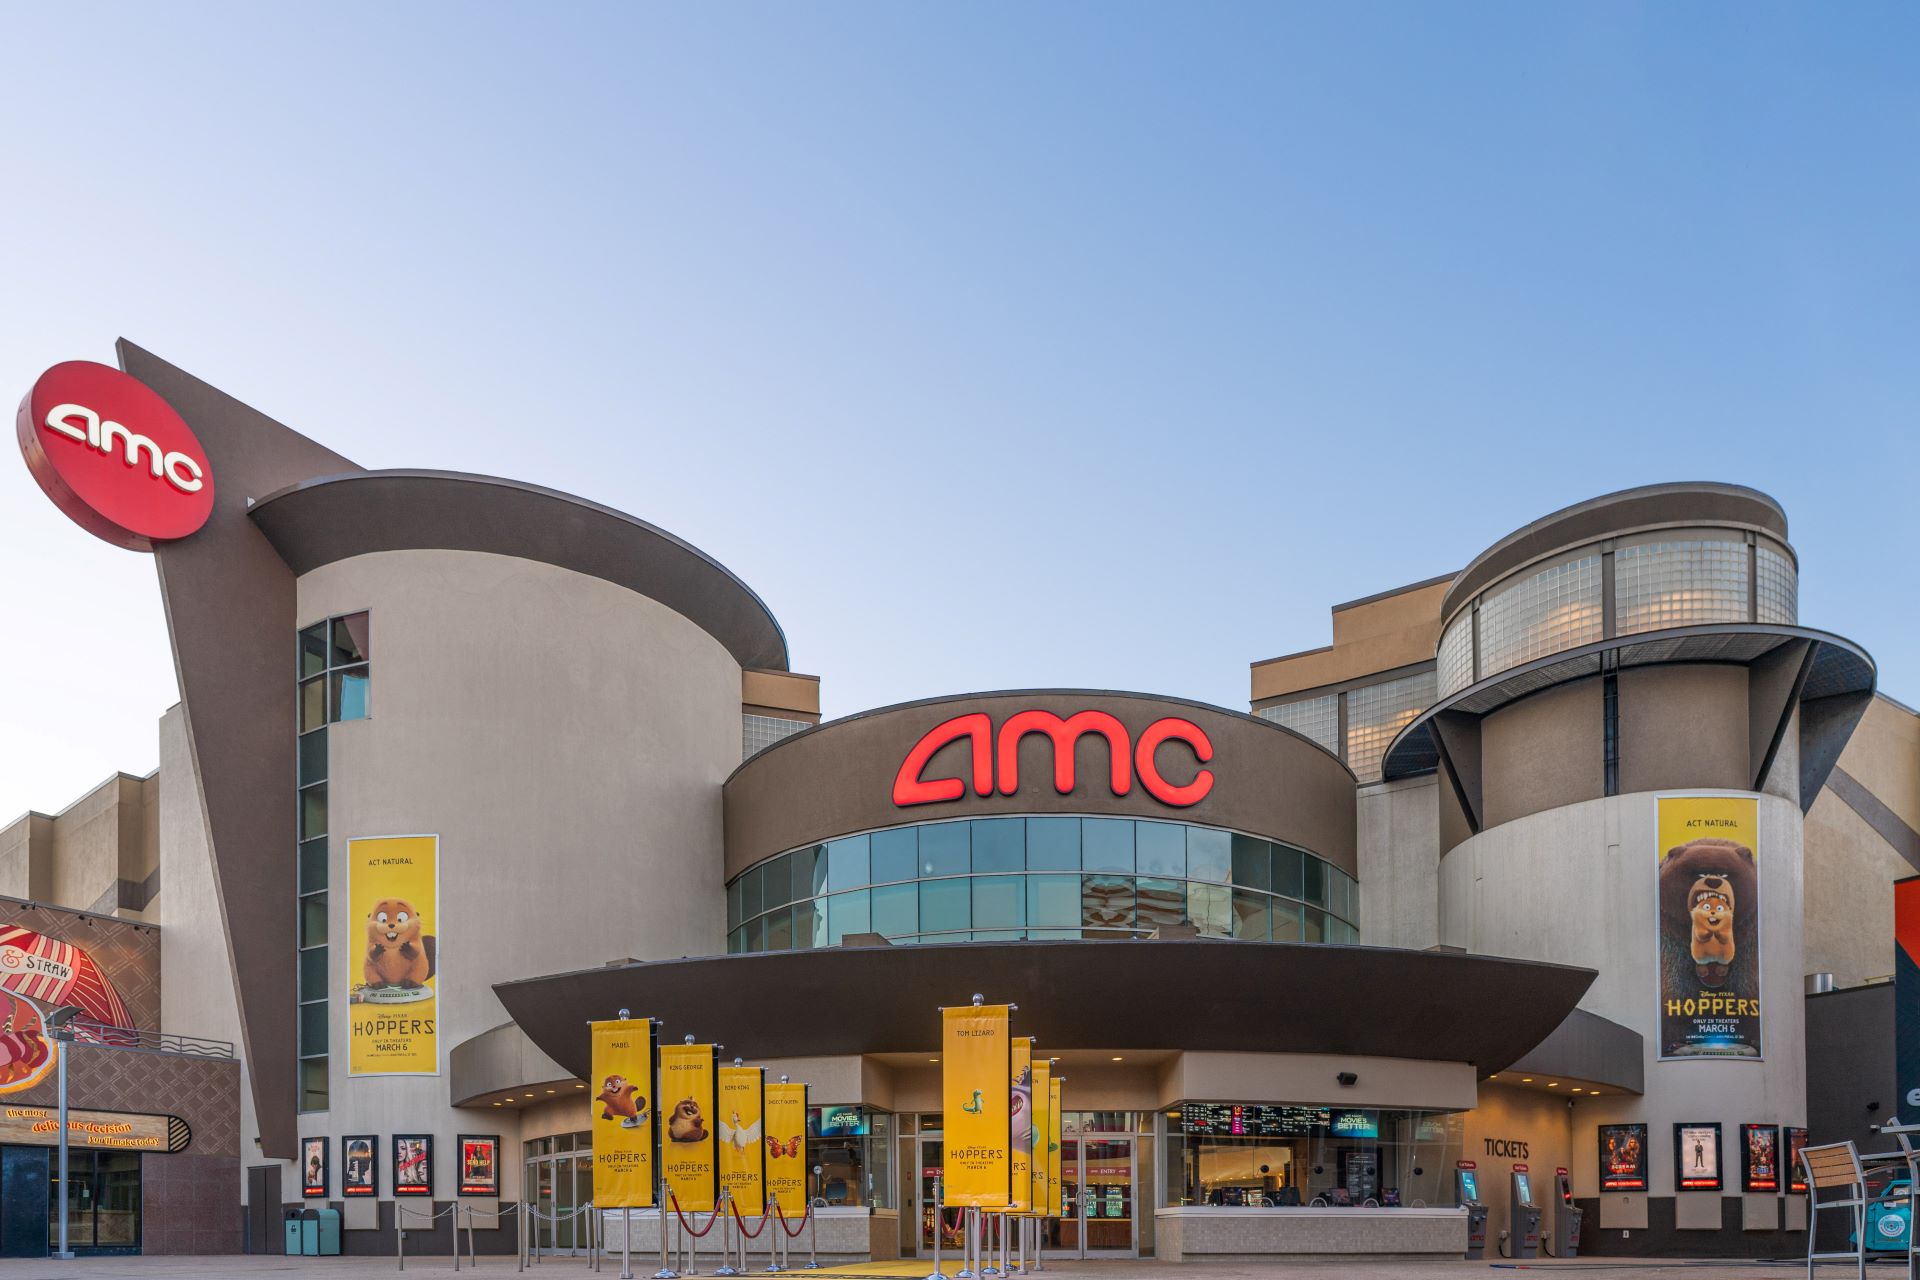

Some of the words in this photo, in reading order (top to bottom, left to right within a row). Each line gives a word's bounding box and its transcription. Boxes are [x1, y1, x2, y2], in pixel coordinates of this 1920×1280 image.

[45, 403, 203, 492] amc
[892, 709, 1214, 807] amc
[1686, 819, 1702, 827] ACT
[1704, 819, 1738, 828] NATURAL
[368, 858, 380, 866] ACT
[382, 857, 413, 865] NATURAL
[26, 955, 70, 978] STRAW
[1667, 998, 1759, 1017] HOPPERS
[354, 1020, 435, 1037] HOPPERS
[971, 1029, 994, 1037] LIZARD
[1698, 1024, 1728, 1033] MARCH
[1729, 1024, 1736, 1033] 6
[376, 1043, 401, 1051] MARCH
[402, 1043, 408, 1051] 6
[7, 1108, 24, 1118] the
[24, 1110, 48, 1118] most
[85, 1122, 133, 1134] decision
[112, 1138, 136, 1146] make
[136, 1137, 160, 1146] today
[1484, 1138, 1529, 1159] TICKETS
[599, 1153, 647, 1163] HOPPERS
[951, 1149, 1003, 1159] HOPPERS
[667, 1163, 709, 1173] HOPPERS
[720, 1173, 758, 1181] HOPPERS
[766, 1179, 802, 1187] HOPPERS
